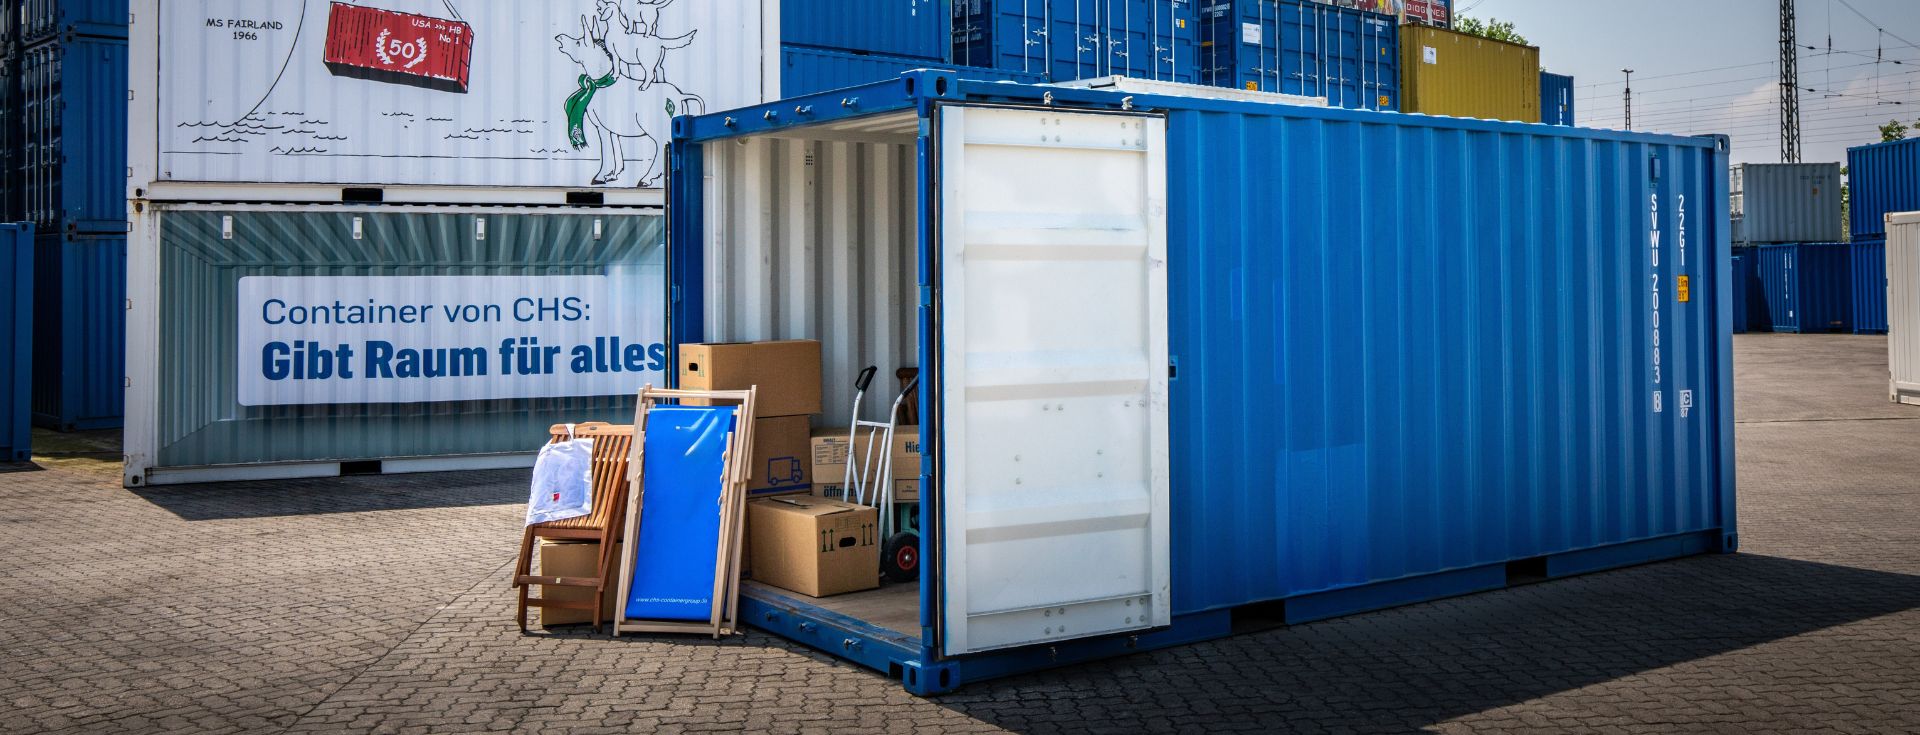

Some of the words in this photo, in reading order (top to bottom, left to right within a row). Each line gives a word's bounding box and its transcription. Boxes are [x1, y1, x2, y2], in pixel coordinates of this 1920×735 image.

[1406, 3, 1445, 18] DIOGNES
[206, 18, 223, 27] MS
[228, 20, 283, 30] FAIRLAND
[412, 18, 431, 28] USA
[449, 26, 462, 35] HB
[233, 31, 257, 41] 1966
[439, 33, 451, 43] No
[455, 36, 459, 45] 1
[389, 39, 415, 59] 50
[1650, 193, 1660, 266] SVWU
[262, 298, 433, 325] Container
[443, 303, 501, 323] von
[513, 296, 590, 322] CHS:
[1652, 273, 1661, 384] 200883
[262, 339, 354, 381] Gibt
[364, 340, 488, 379] Raum
[499, 336, 561, 376] für
[570, 336, 665, 374] alles
